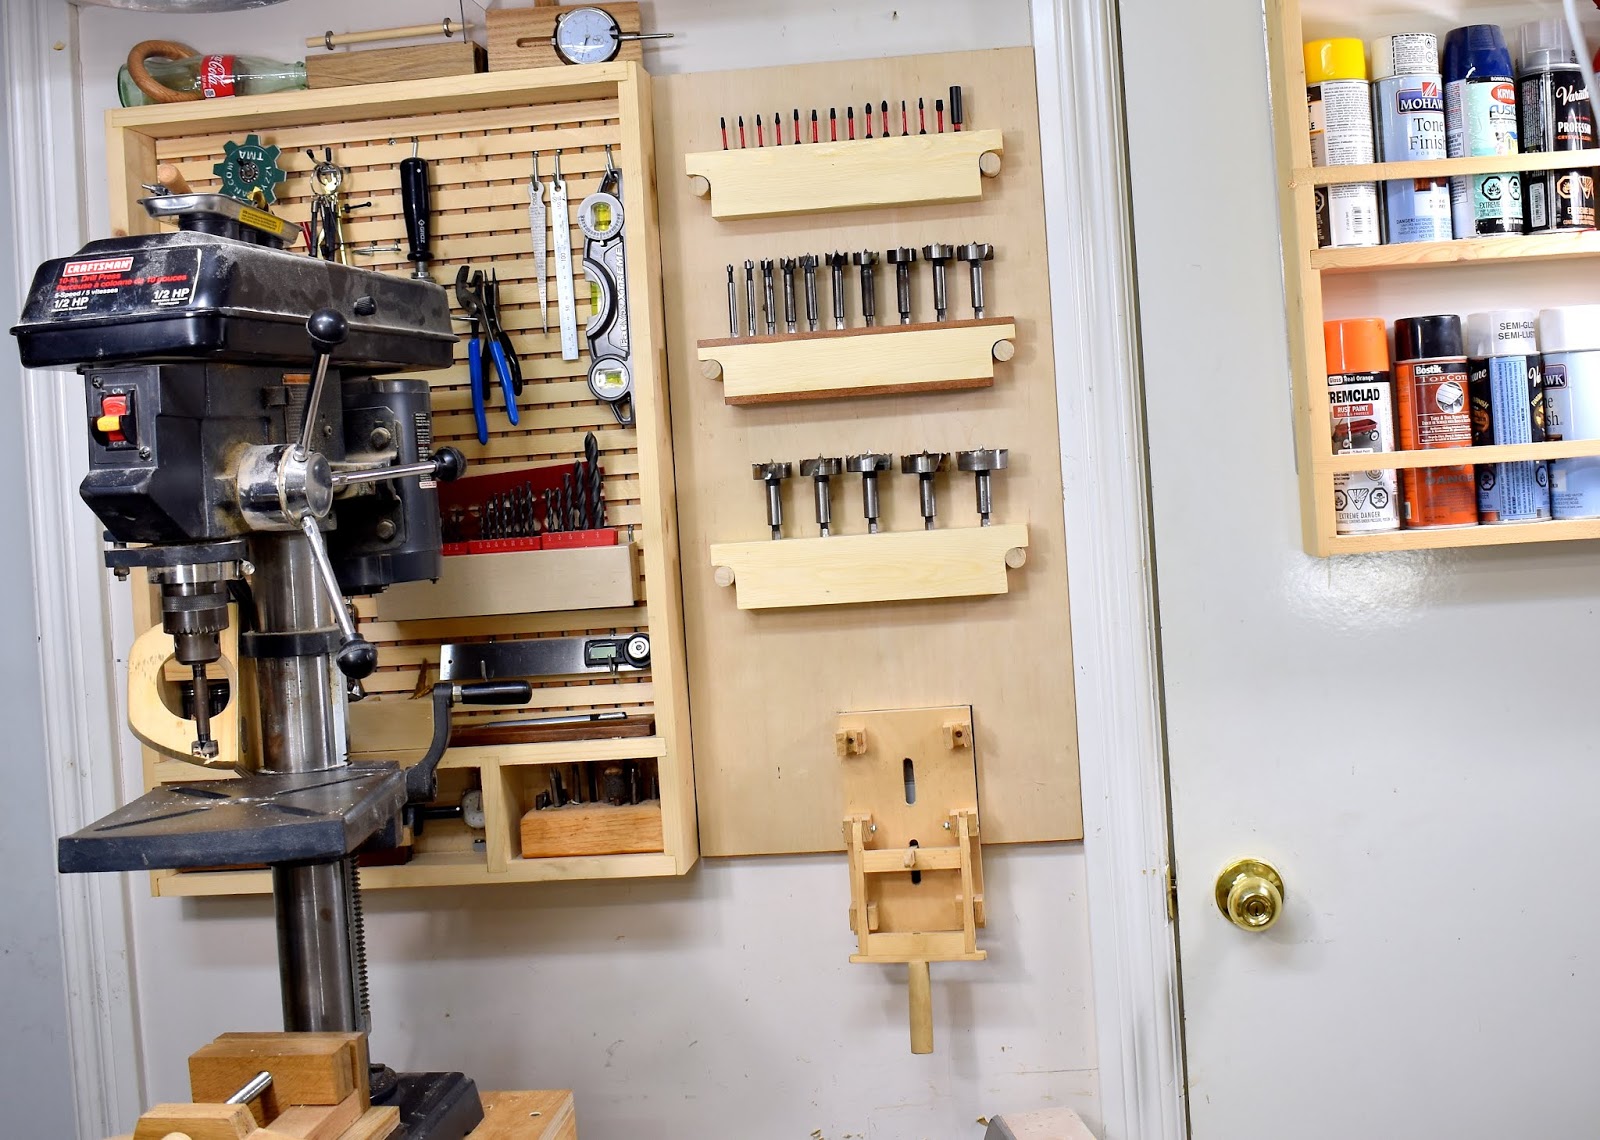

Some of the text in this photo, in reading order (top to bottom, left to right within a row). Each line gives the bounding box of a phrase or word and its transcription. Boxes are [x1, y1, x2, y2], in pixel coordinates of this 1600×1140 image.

[1400, 98, 1443, 110] MOHAW
[1413, 117, 1444, 132] Tone
[238, 150, 264, 161] TMA
[67, 259, 131, 274] CRAFTSMAN
[55, 282, 93, 291] Perceuse
[100, 278, 133, 288] colonne
[147, 276, 156, 284] 10
[156, 274, 188, 284] pouces
[80, 274, 98, 284] Drill
[98, 273, 122, 281] Press
[54, 290, 82, 299] 5-Speed
[153, 287, 190, 300] 1/2 HP
[53, 299, 70, 309] 1/2
[71, 296, 90, 307] HP
[1499, 321, 1535, 331] SEMI-GLO
[1415, 364, 1443, 375] Bostik
[1328, 388, 1381, 404] REMCLAD
[1339, 511, 1381, 520] EXTREME DANGER
